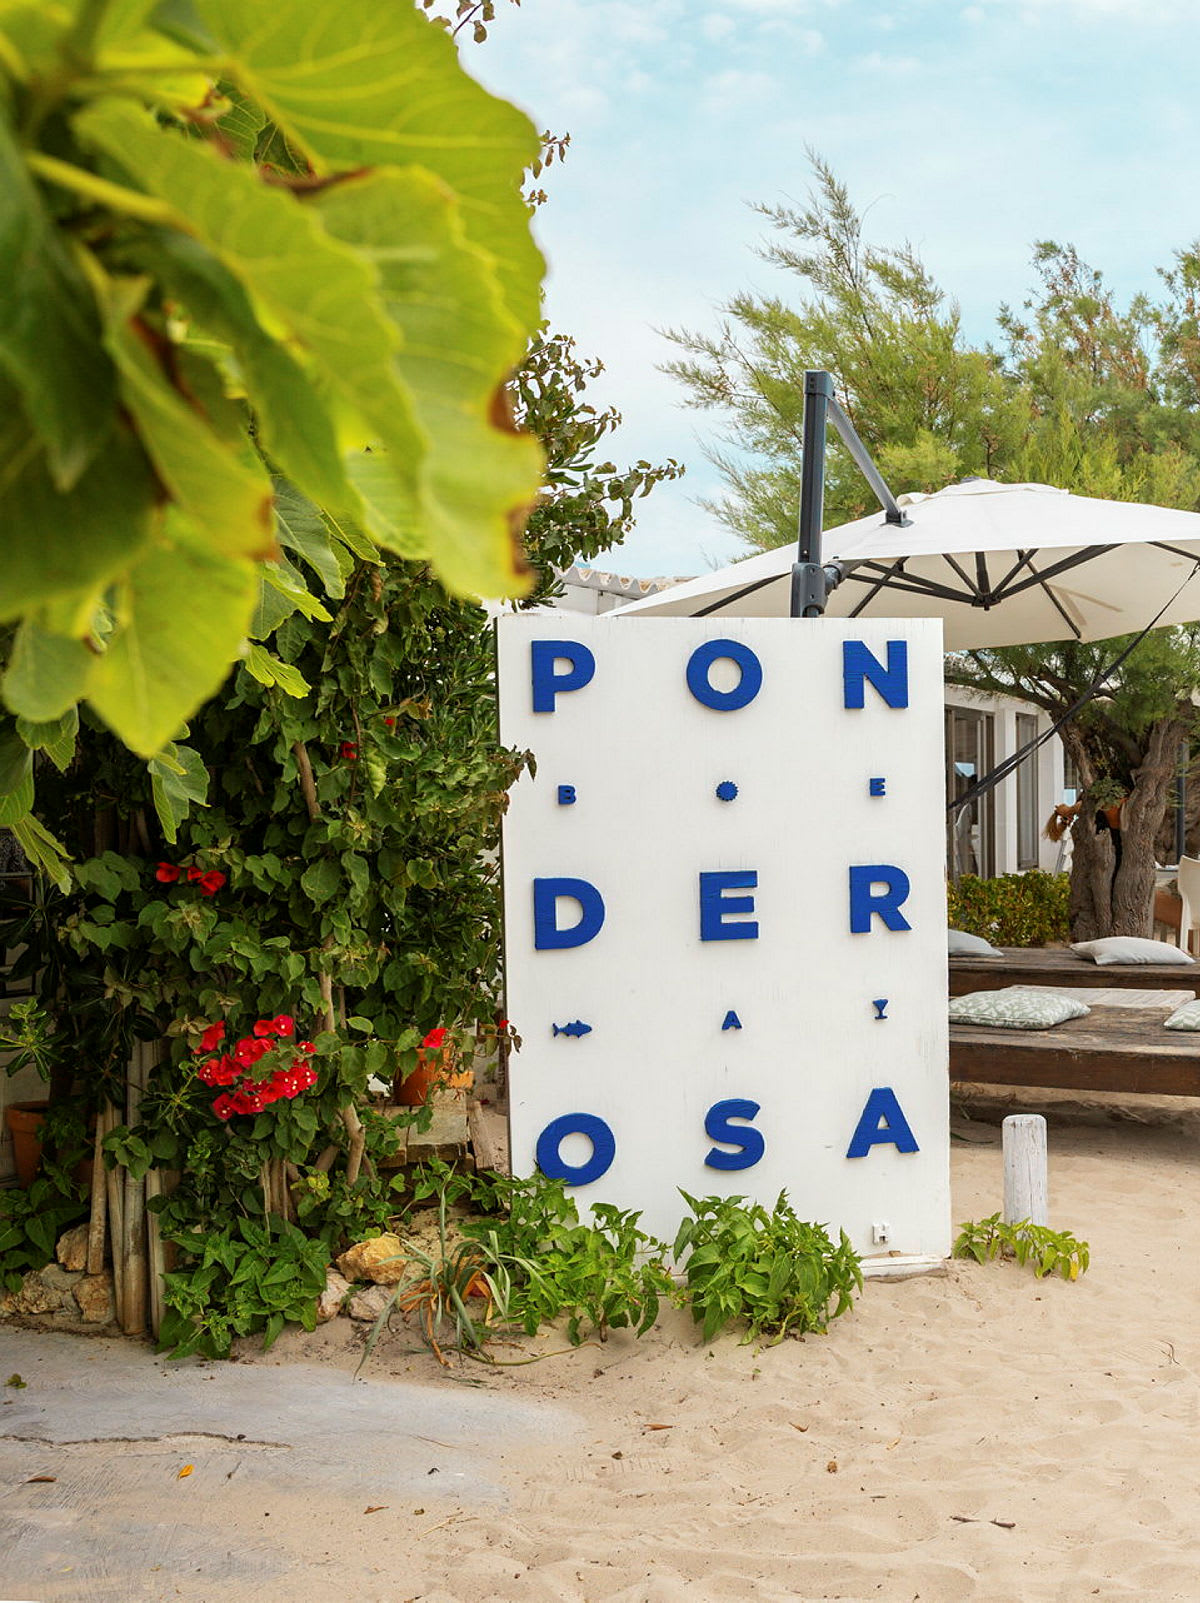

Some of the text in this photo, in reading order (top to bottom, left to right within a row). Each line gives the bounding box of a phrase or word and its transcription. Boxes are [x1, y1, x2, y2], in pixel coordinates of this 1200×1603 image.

[532, 638, 910, 713] PON
[558, 777, 886, 805] B E
[533, 864, 912, 950] DER
[721, 1010, 742, 1031] A
[536, 1086, 921, 1187] OSA
